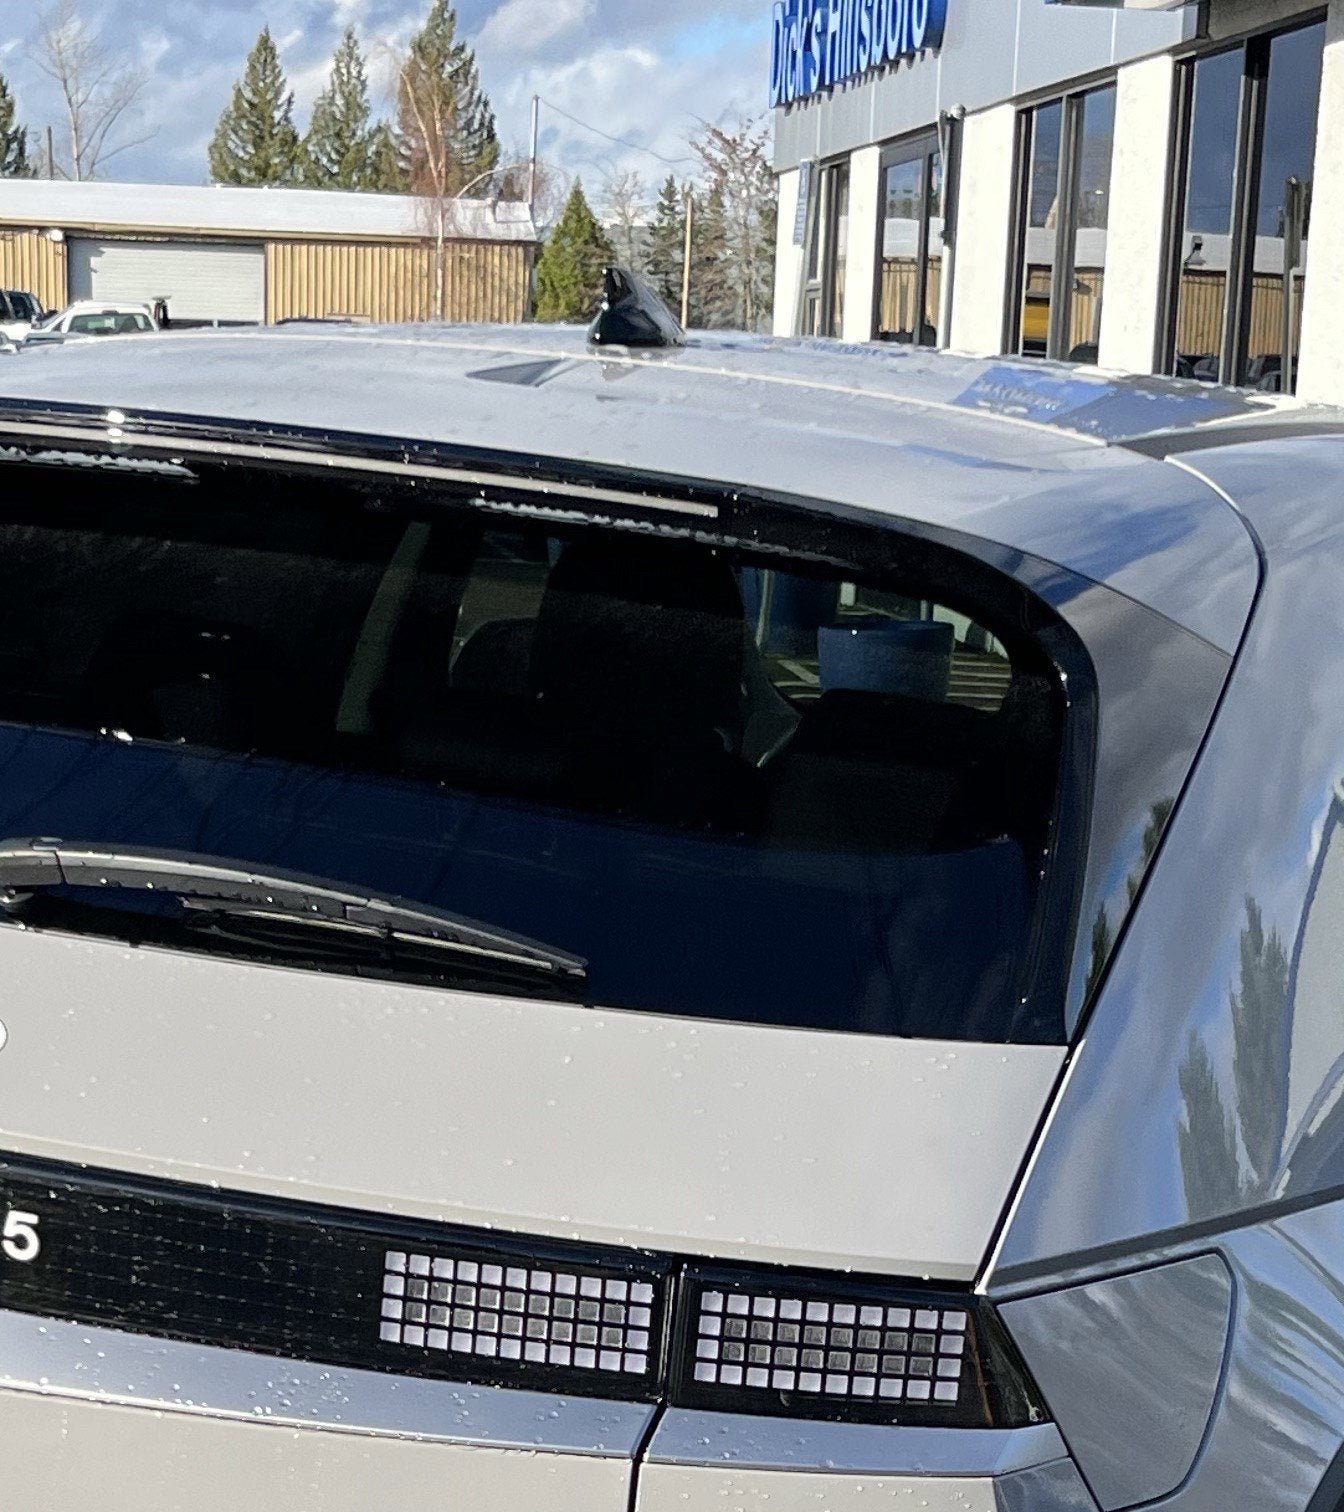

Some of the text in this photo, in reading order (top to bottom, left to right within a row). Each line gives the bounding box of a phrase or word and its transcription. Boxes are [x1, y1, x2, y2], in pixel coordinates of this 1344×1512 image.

[769, 0, 930, 109] Dick's Hillsboro
[1, 1210, 41, 1262] 5
